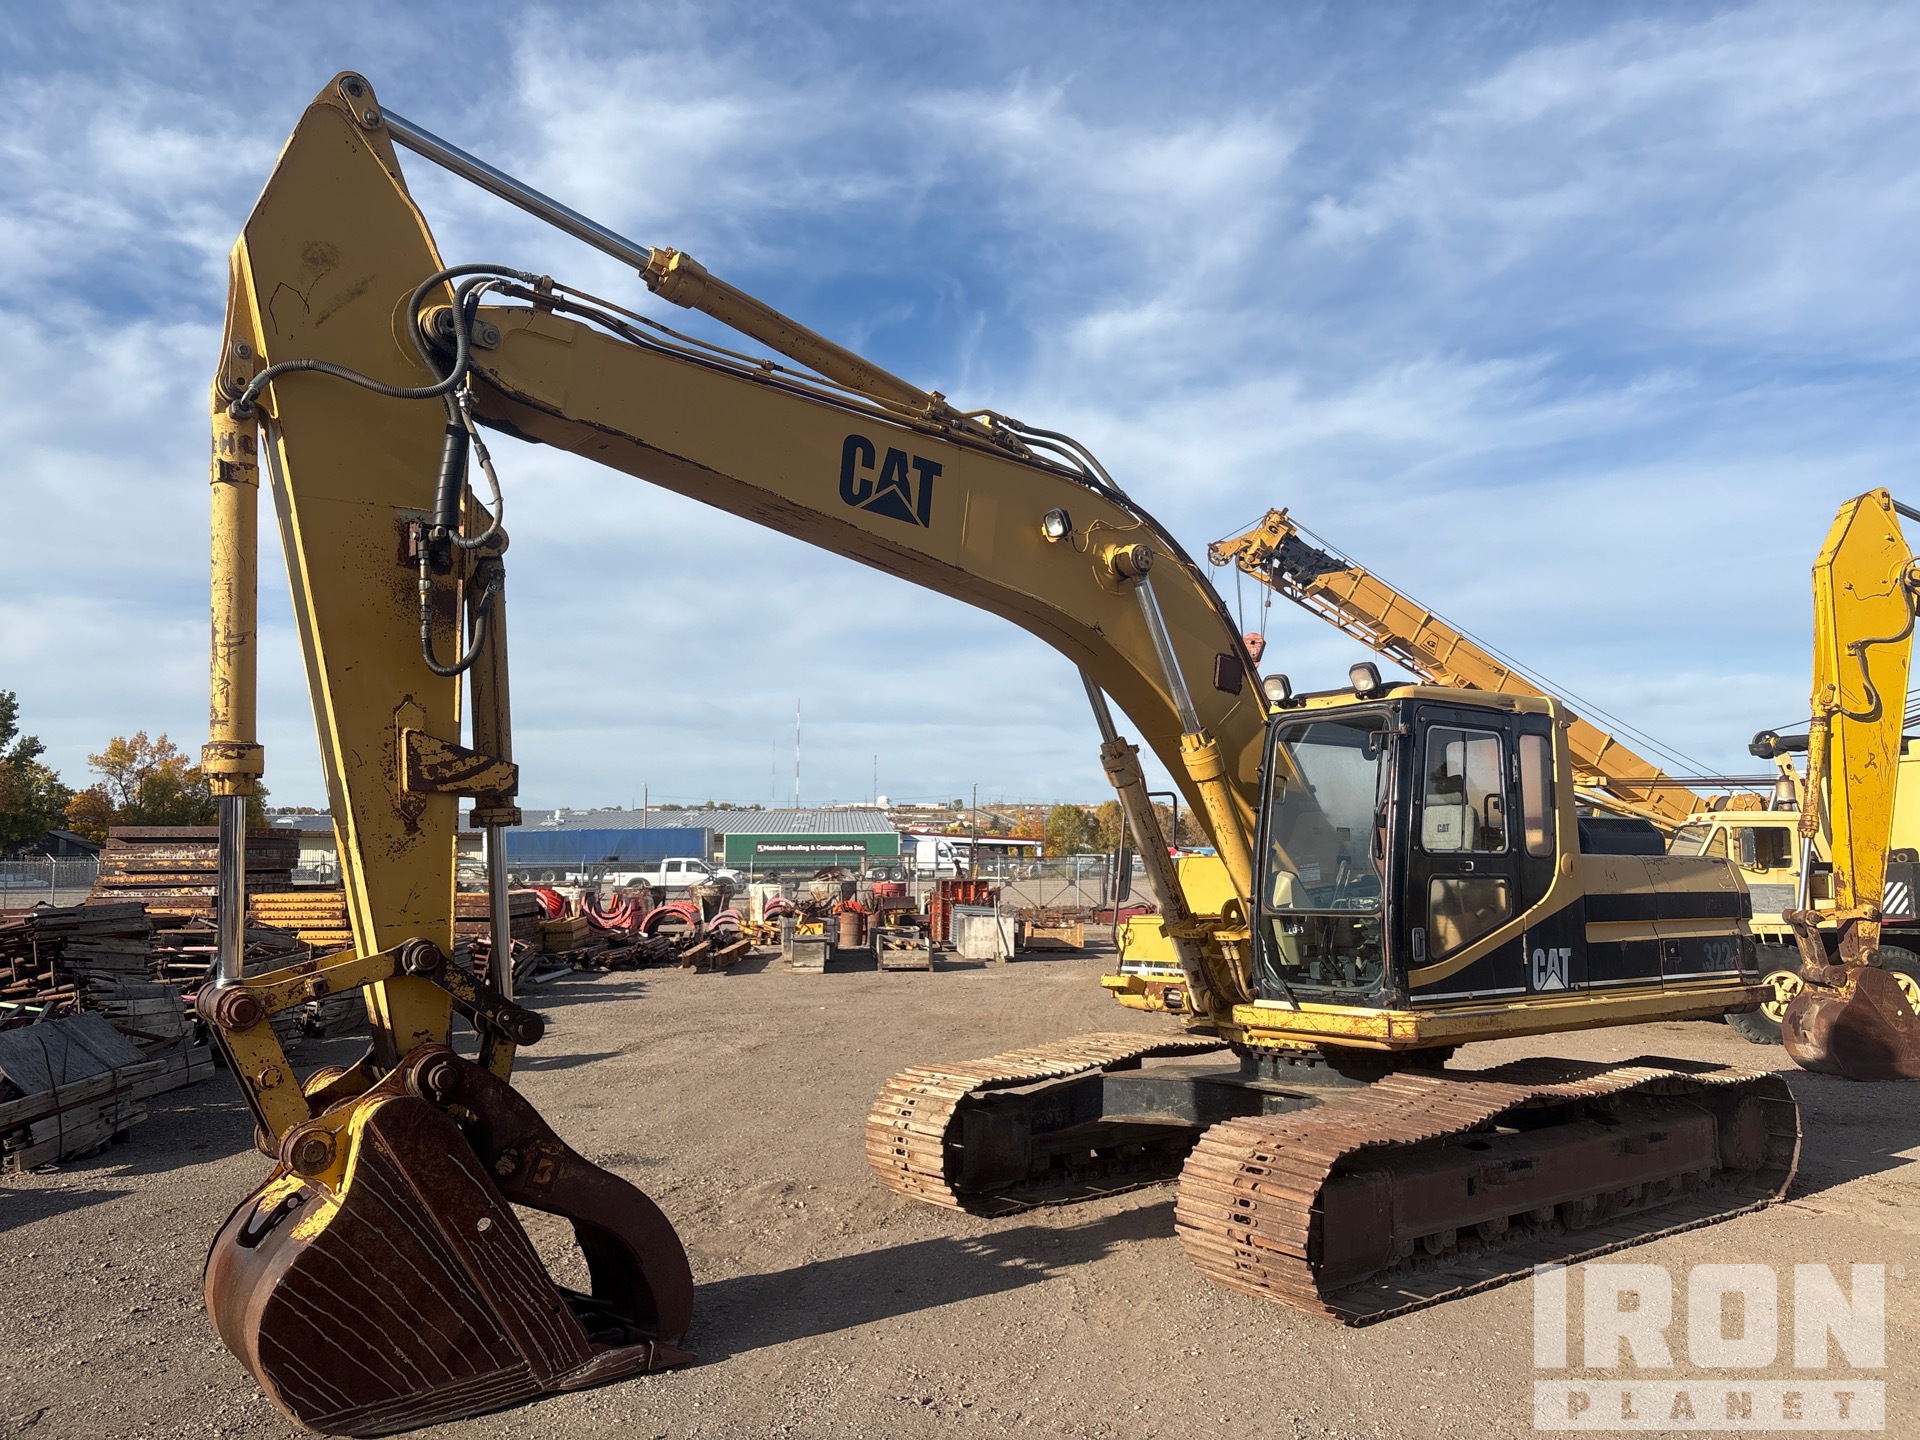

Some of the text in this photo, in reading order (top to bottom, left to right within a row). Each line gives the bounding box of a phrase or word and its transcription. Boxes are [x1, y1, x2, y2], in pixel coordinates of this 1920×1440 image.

[839, 434, 943, 529] CAT
[1437, 823, 1450, 833] CAT
[787, 844, 810, 852] Roofing
[1532, 948, 1572, 991] CAT
